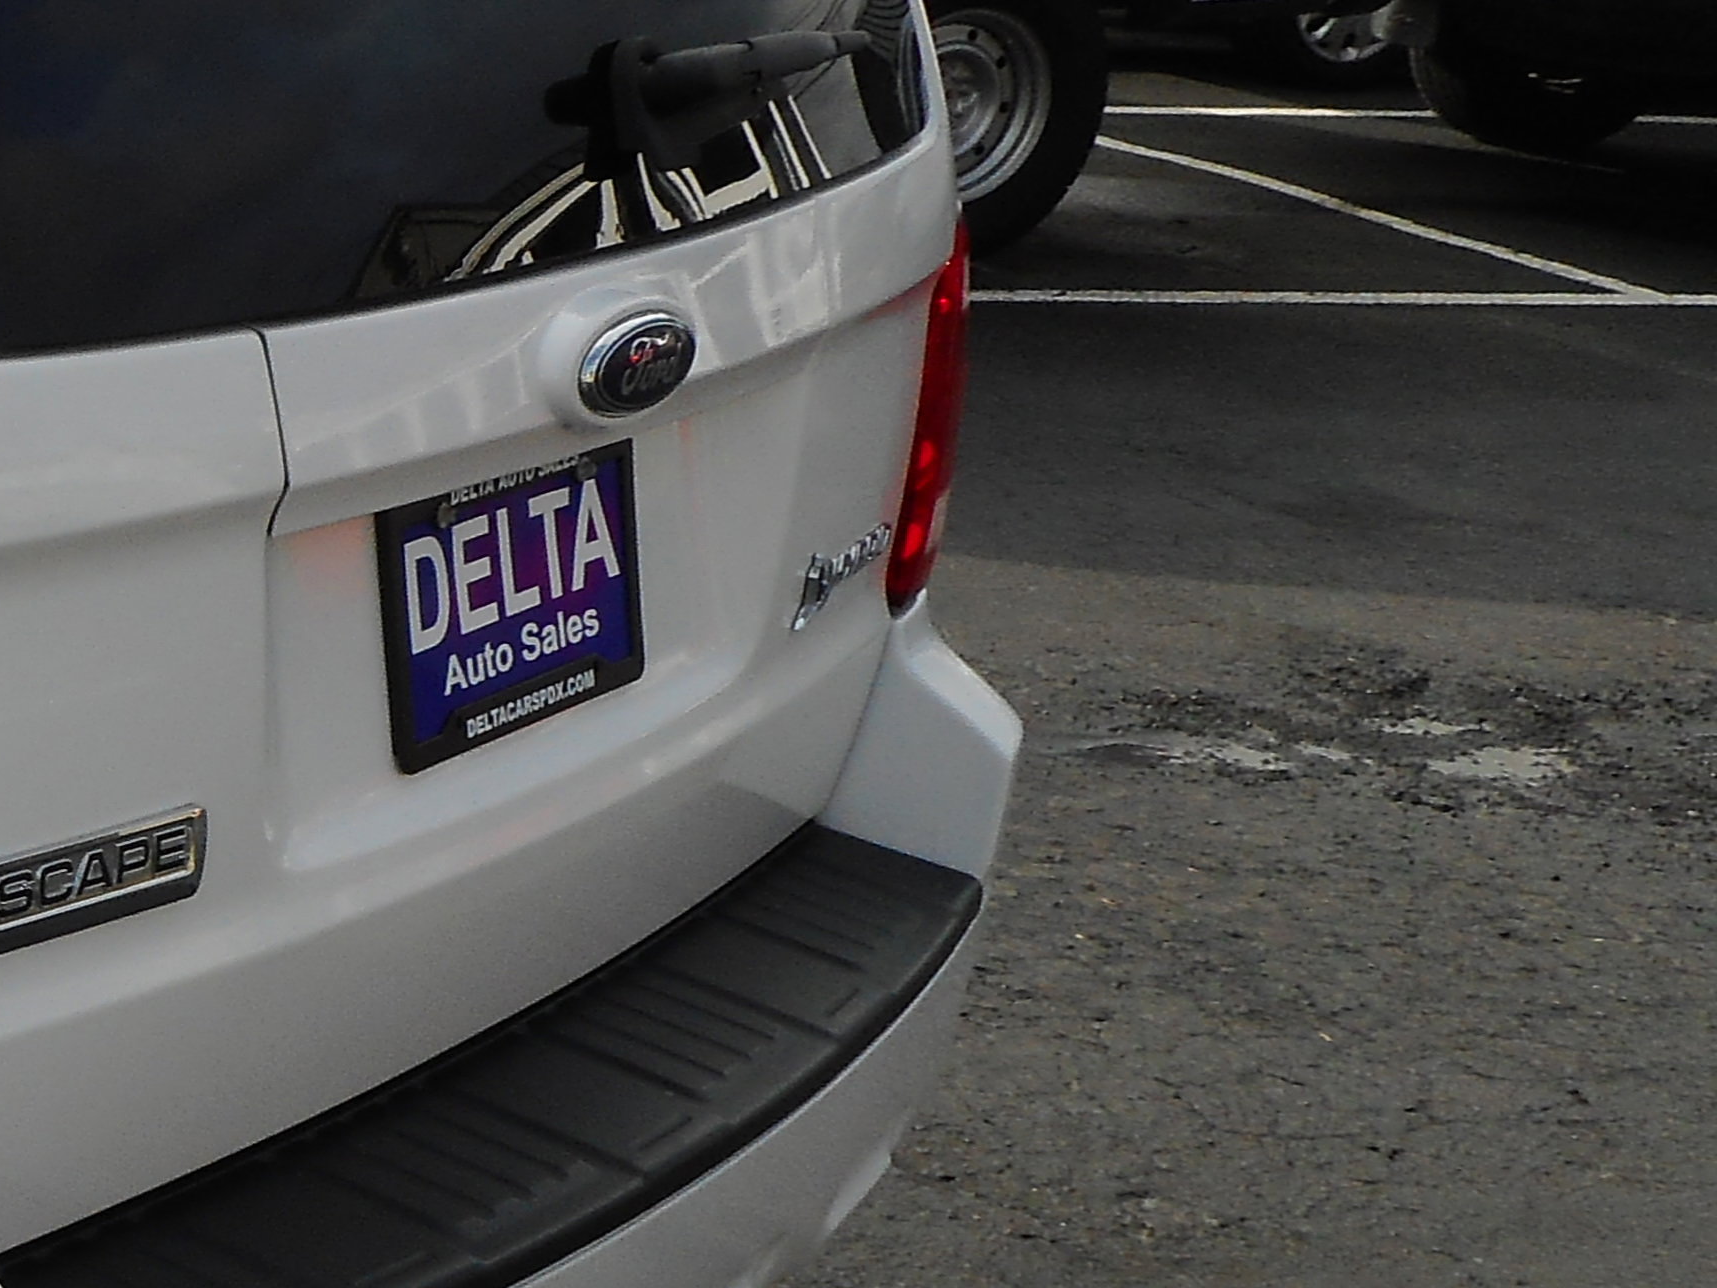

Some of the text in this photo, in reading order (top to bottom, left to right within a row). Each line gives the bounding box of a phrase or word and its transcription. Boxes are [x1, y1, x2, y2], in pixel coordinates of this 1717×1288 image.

[403, 478, 621, 656] DELTA
[443, 607, 601, 697] Auto Sales
[466, 669, 595, 740] DELTACARSPDX.COM
